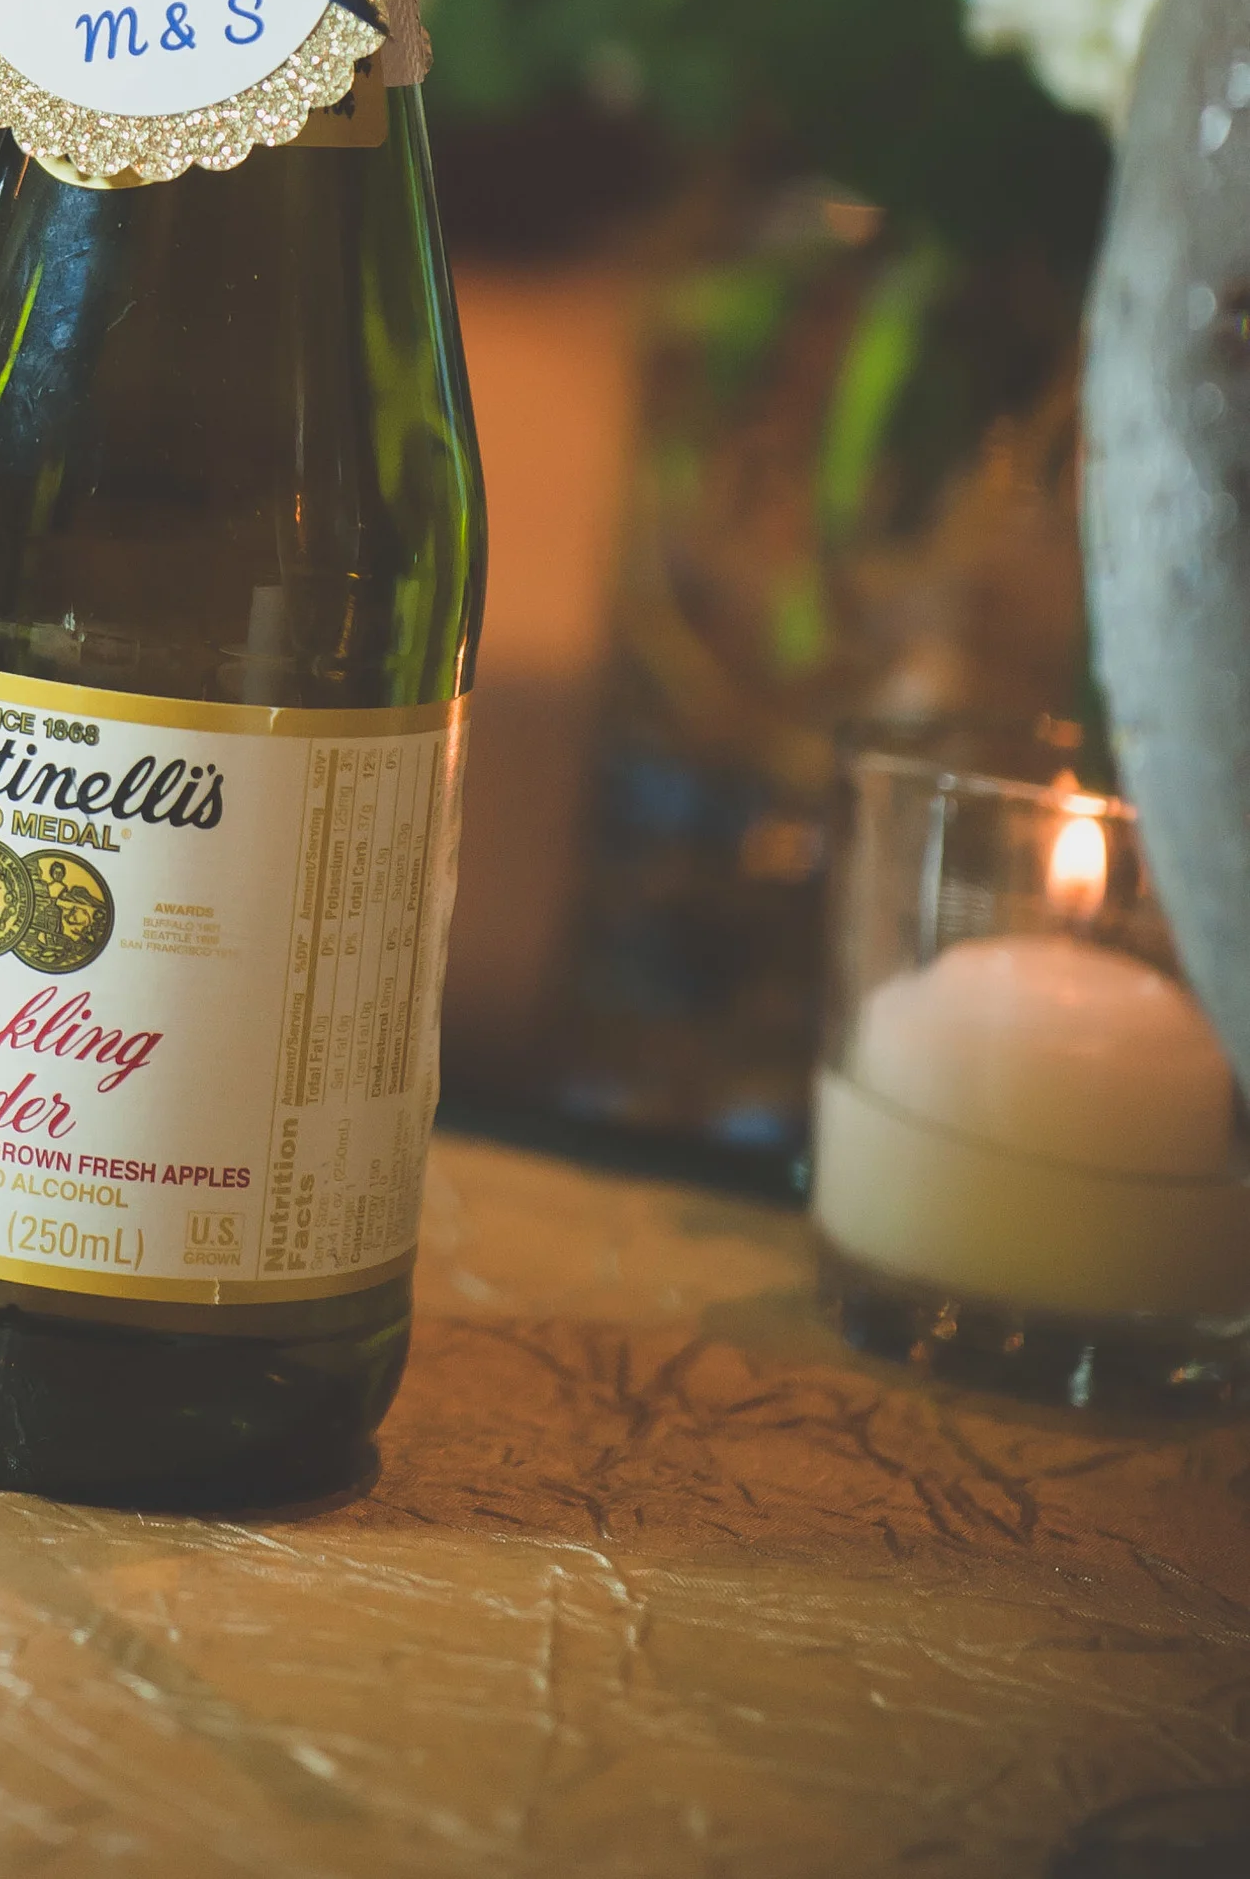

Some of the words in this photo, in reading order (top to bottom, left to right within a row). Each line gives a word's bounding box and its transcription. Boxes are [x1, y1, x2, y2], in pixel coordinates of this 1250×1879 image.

[75, 6, 149, 62] M
[160, 2, 196, 51] &
[42, 718, 101, 746] 1868
[300, 807, 326, 920] Amount/Serving
[324, 840, 345, 920] Potassium
[351, 838, 368, 876] Carb.
[154, 902, 214, 918] AWARDS
[348, 882, 363, 920] Total
[406, 858, 421, 912] Protein
[282, 992, 304, 1105] Amount/Serving
[311, 1038, 324, 1062] Fat
[370, 1012, 389, 1098] Cholesterol
[388, 1037, 402, 1095] Sodium
[306, 1068, 321, 1103] Total
[11, 1172, 129, 1209] ALCOHOL
[78, 1155, 157, 1183] FRESH
[161, 1165, 251, 1189] APPLES
[263, 1118, 298, 1272] Nutrition
[7, 1210, 144, 1272] (250mL)
[191, 1216, 239, 1247] U.S.
[287, 1174, 315, 1270] Facts
[350, 1195, 366, 1264] Calories
[183, 1251, 241, 1266] GROWN
